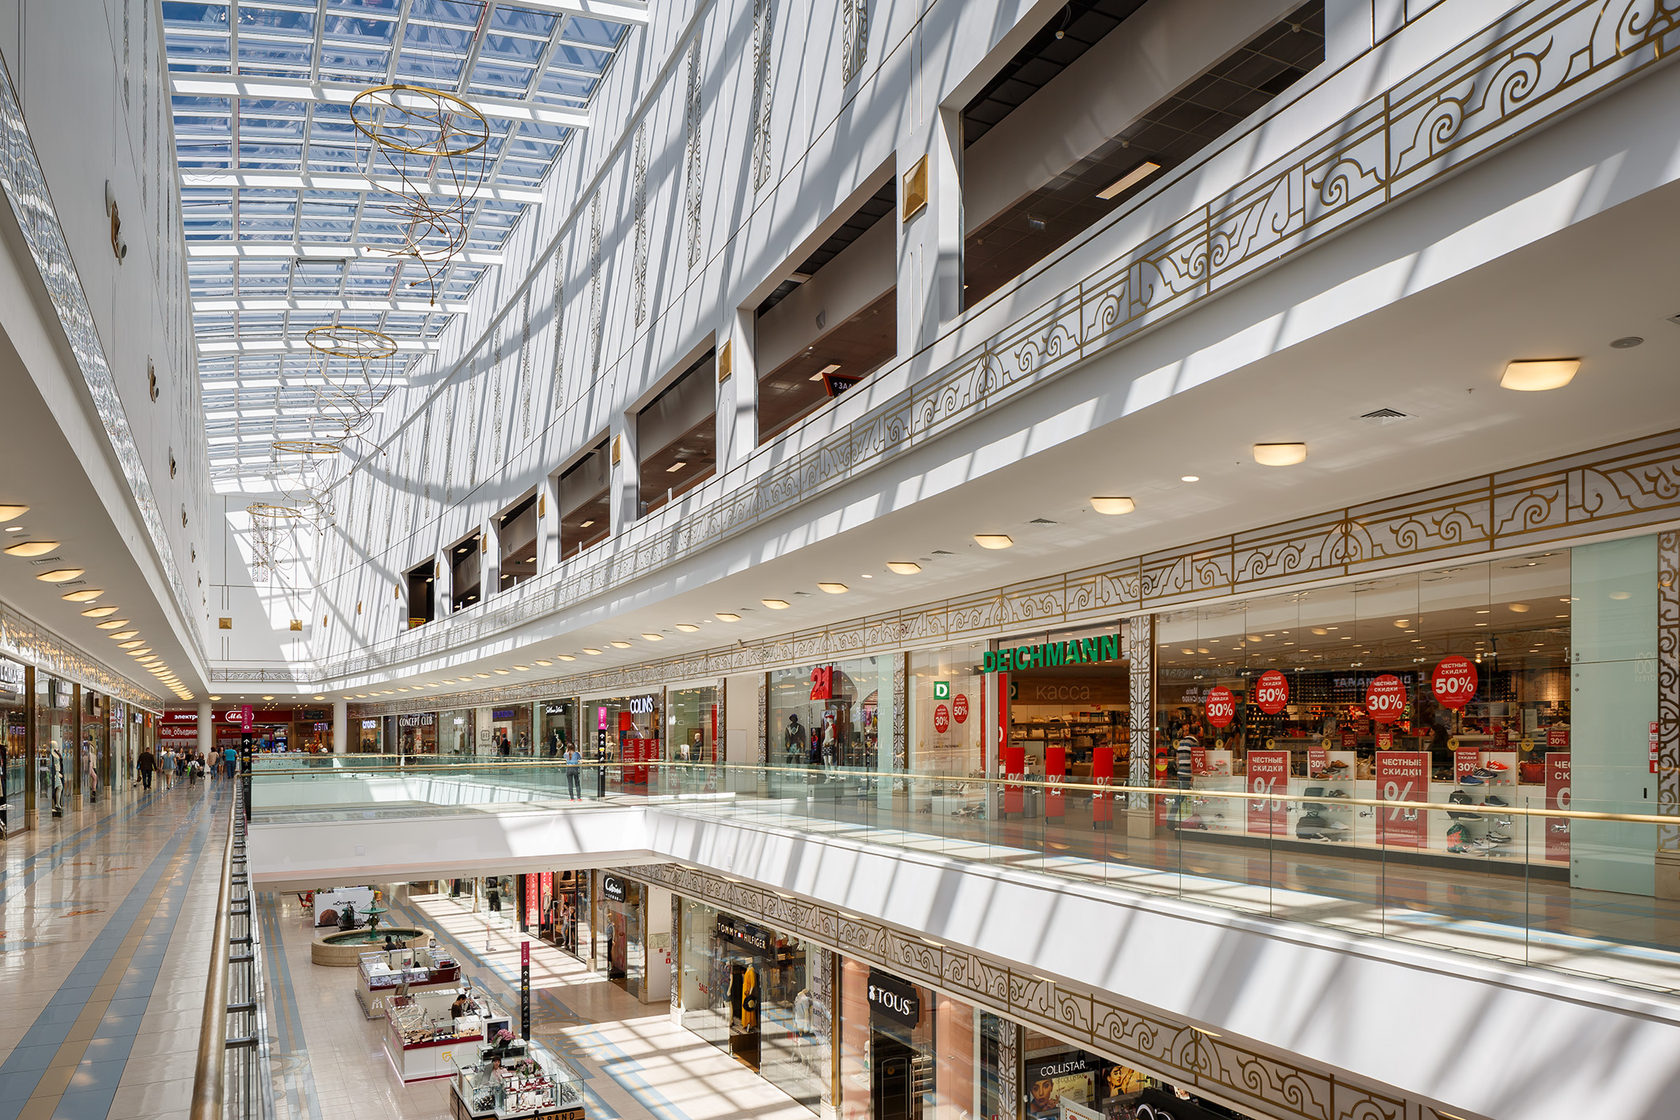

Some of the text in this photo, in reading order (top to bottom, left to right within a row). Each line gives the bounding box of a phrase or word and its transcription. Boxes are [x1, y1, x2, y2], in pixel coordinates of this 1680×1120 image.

[983, 633, 1121, 673] DEICHMANN
[810, 666, 832, 700] 21
[1435, 676, 1474, 694] 50%
[936, 684, 948, 697] D
[1258, 687, 1286, 702] 50%
[630, 695, 654, 714] COLIN'S
[1368, 694, 1403, 710] 30%
[953, 706, 967, 716] 50%
[1208, 703, 1233, 717] 30%
[399, 716, 420, 727] CONCEPT
[935, 717, 948, 726] 30%
[1551, 737, 1566, 745] 30%
[1194, 757, 1204, 768] %
[1252, 756, 1283, 764] ЧЕСТНЫЕ
[1311, 760, 1326, 768] 30%
[1382, 758, 1422, 766] ЧЕСТНЫЕ
[1457, 762, 1477, 772] 30%
[1382, 768, 1422, 776] СКИДКИ
[1253, 776, 1281, 812] %
[1384, 781, 1418, 821] %
[717, 922, 766, 949] TOMMY HILFIGER
[876, 987, 910, 1016] TOUS
[1040, 1060, 1086, 1077] COLLISTAR
